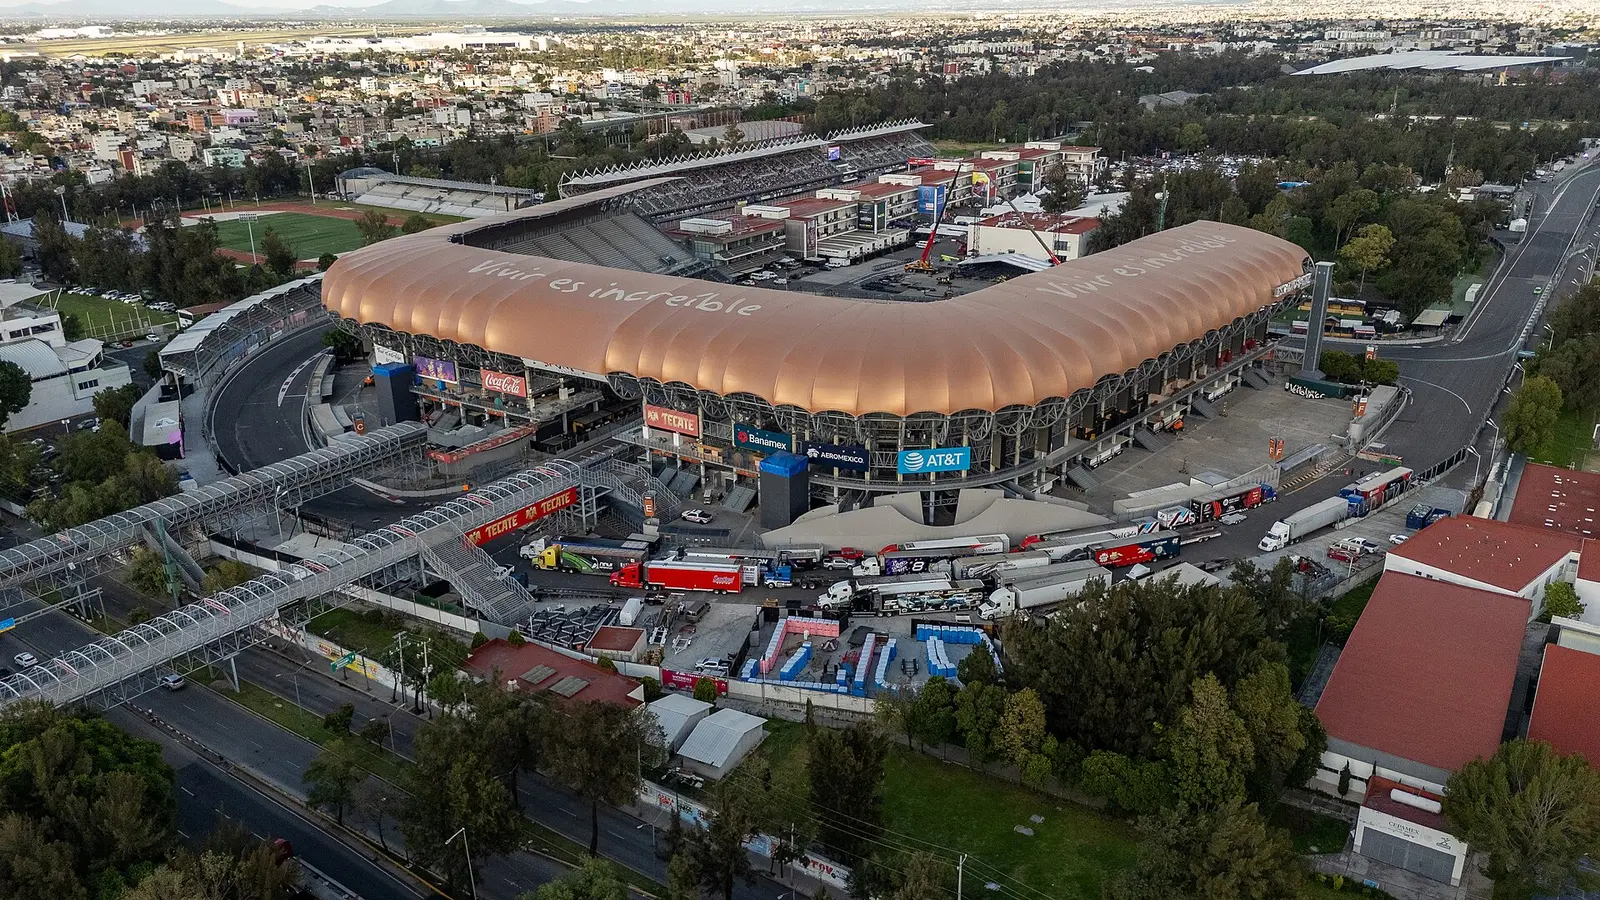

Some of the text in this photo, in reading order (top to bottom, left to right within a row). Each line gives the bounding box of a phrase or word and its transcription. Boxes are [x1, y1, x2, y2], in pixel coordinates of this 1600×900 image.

[468, 259, 545, 280] Vivir
[549, 278, 585, 293] es
[1036, 275, 1113, 299] Vivir
[1113, 264, 1146, 277] es
[356, 423, 364, 431] C
[662, 414, 695, 431] TECATE
[749, 433, 787, 451] Banamex
[926, 453, 963, 467] AT&T
[541, 491, 571, 514] TECATE
[645, 504, 653, 513] E
[485, 515, 518, 538] TECATE
[911, 561, 925, 572] 8
